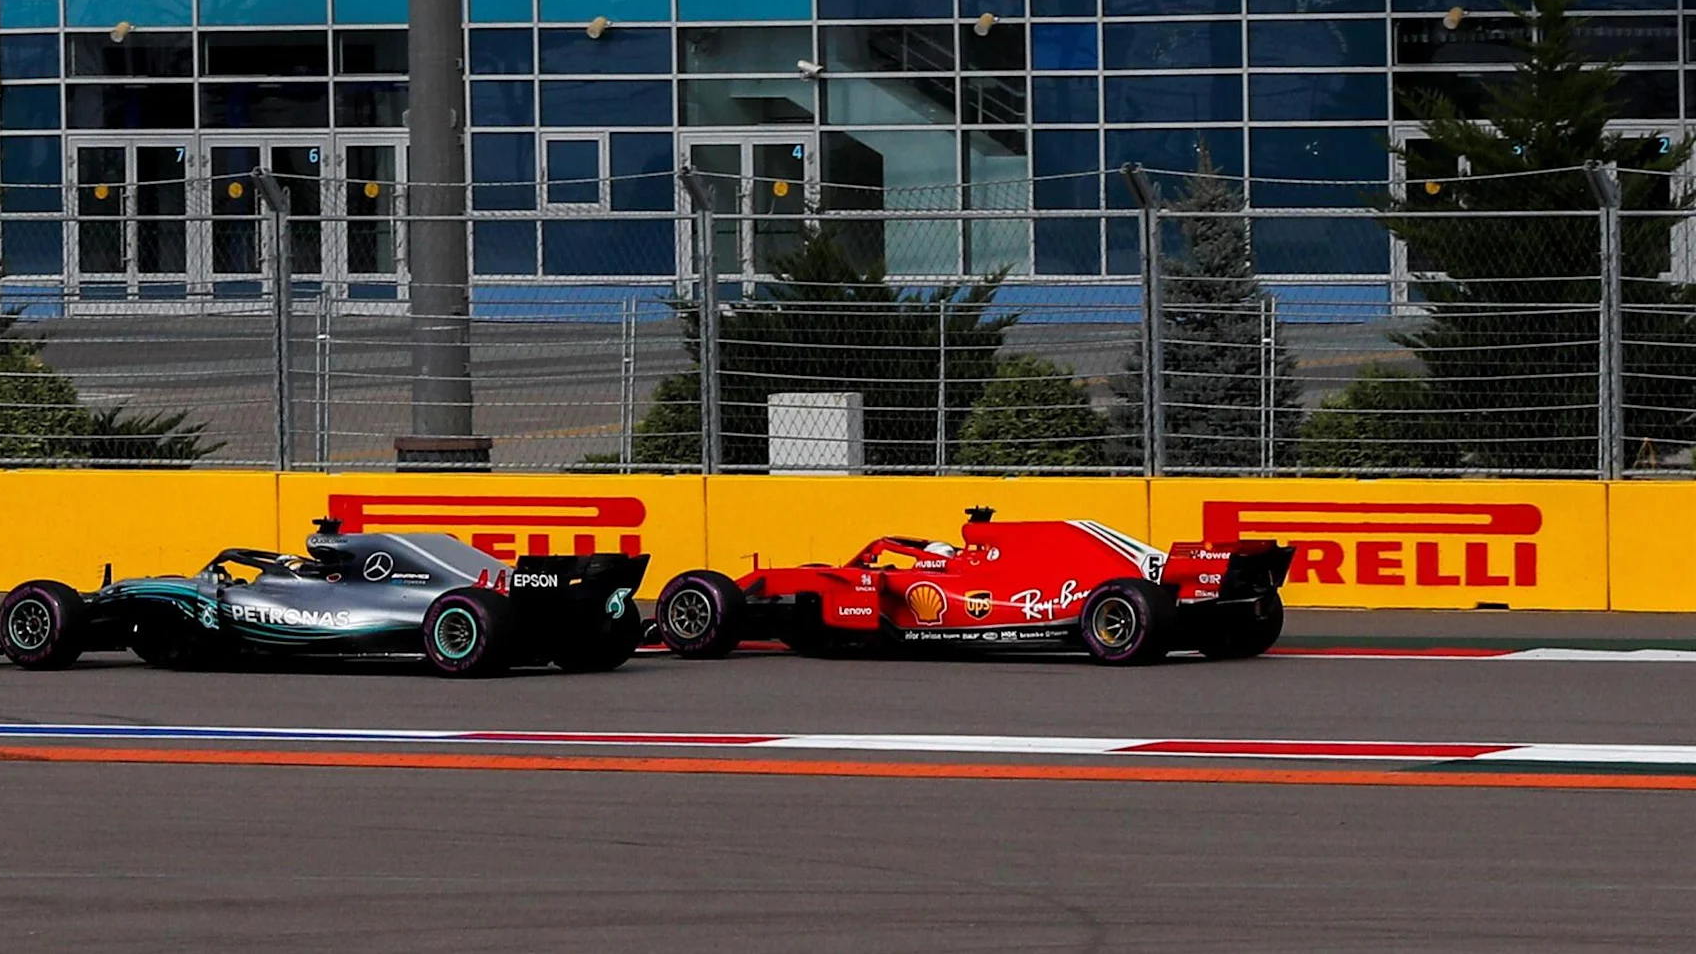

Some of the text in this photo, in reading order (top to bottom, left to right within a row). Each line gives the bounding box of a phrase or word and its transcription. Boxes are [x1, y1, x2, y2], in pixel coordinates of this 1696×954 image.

[792, 145, 803, 160] 4
[1659, 138, 1670, 154] 2
[176, 148, 185, 163] 7
[309, 148, 319, 163] 6
[1203, 501, 1542, 587] PRELLI
[915, 559, 946, 568] HUBLOT
[1148, 556, 1161, 581] 5
[514, 574, 558, 588] EPSON
[838, 606, 873, 616] Lenovo
[966, 597, 991, 615] ups
[231, 604, 350, 627] PETRONAS
